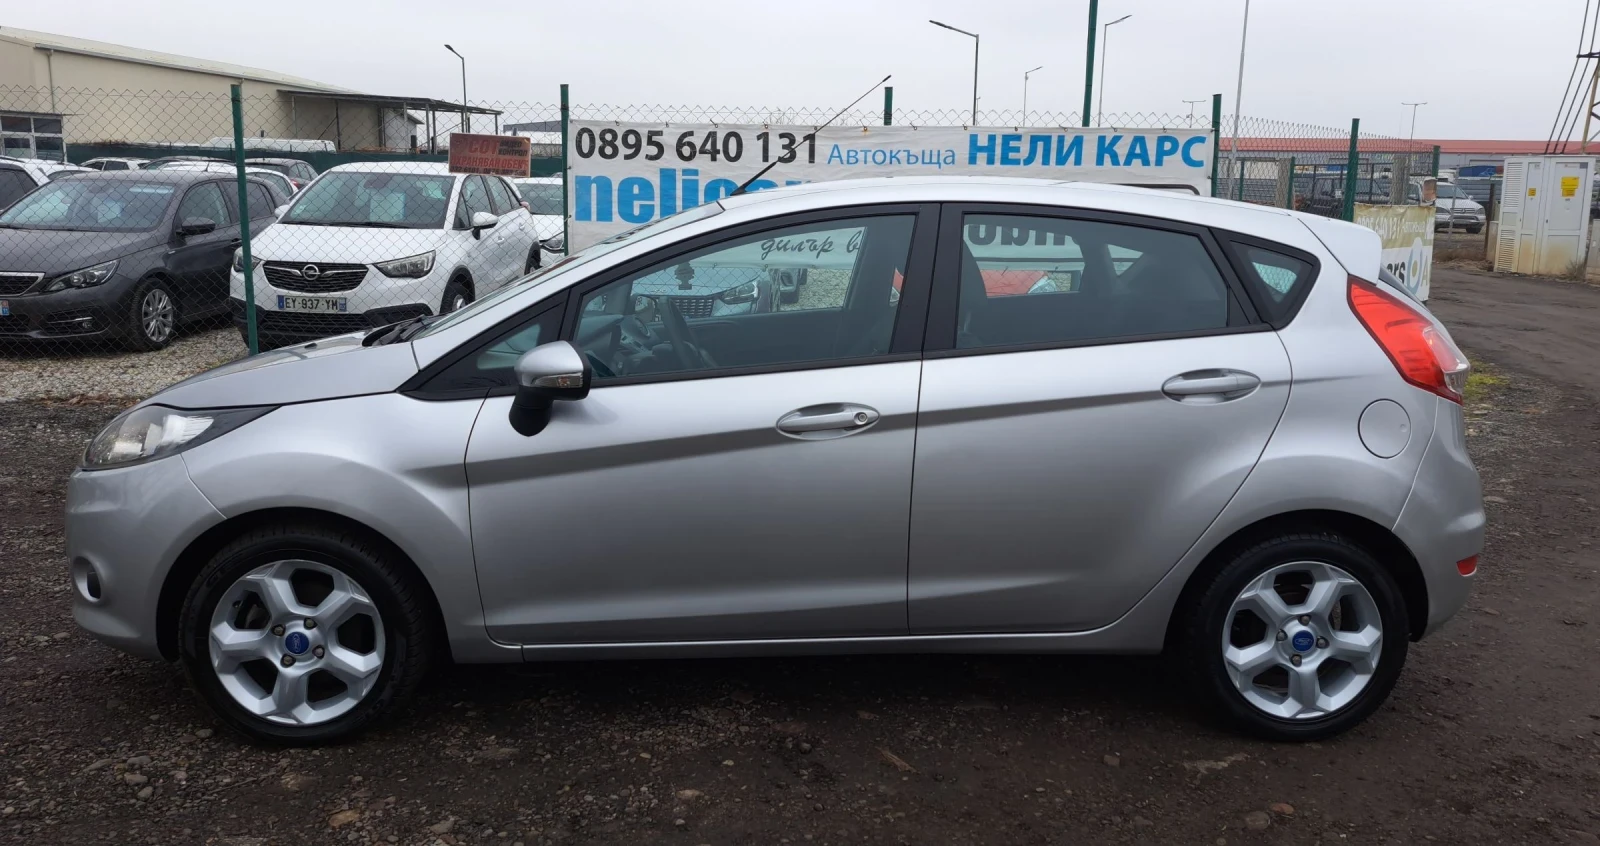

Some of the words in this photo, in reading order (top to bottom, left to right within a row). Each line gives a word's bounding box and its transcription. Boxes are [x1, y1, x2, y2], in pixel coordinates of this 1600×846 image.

[575, 127, 664, 161] 0895
[675, 130, 743, 163] 640
[756, 132, 816, 164] 131
[827, 144, 956, 169] Автокъща
[968, 133, 1084, 167] НЕЛИ
[1096, 135, 1207, 168] КАРС
[760, 234, 835, 260] дилър
